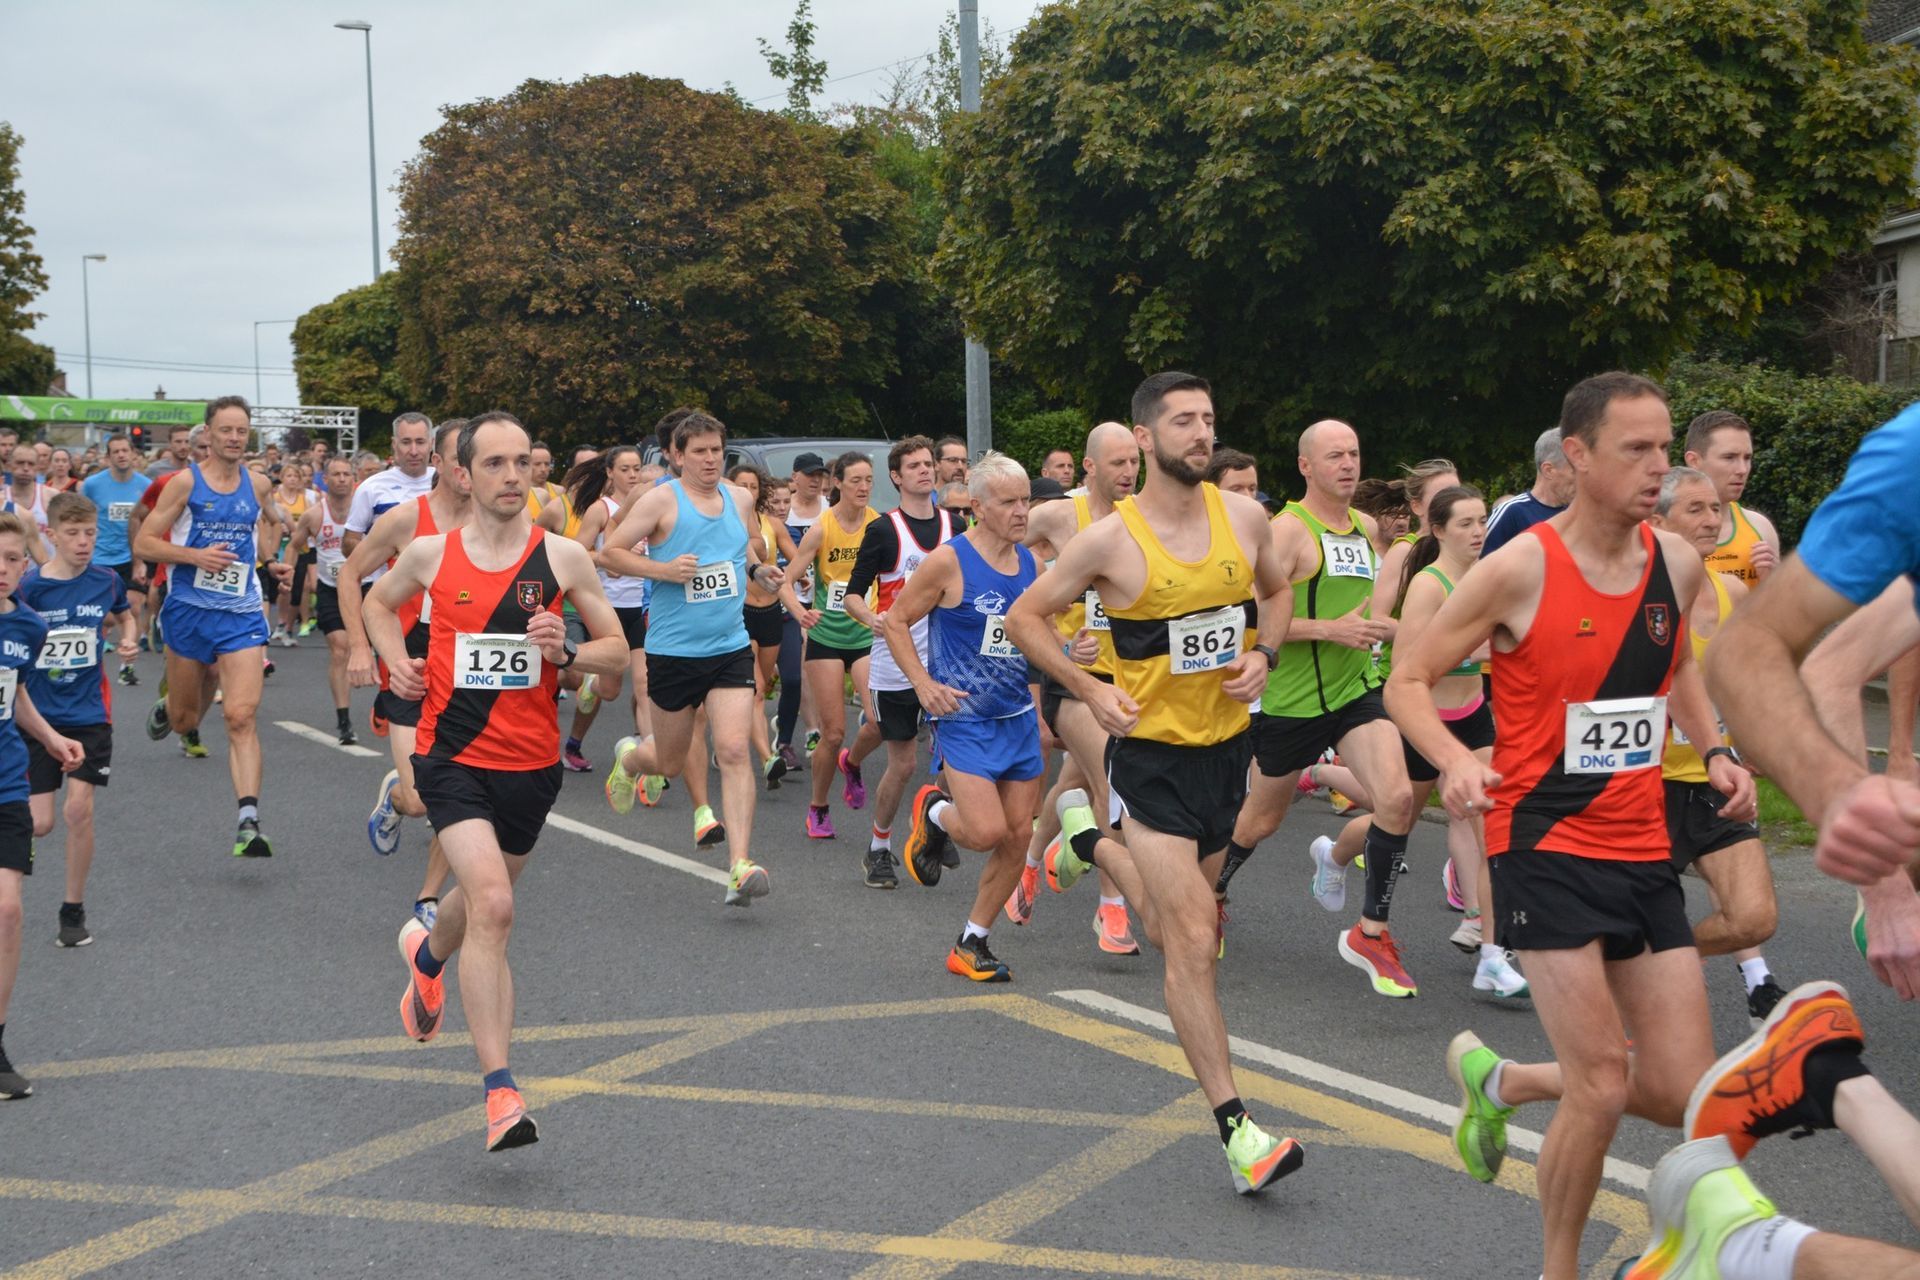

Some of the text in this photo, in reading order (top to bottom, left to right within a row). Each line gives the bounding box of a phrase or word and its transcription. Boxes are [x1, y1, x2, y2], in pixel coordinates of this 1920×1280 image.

[1332, 546, 1366, 565] 191
[1334, 564, 1353, 573] DNG
[201, 580, 220, 589] DNG
[691, 572, 730, 592] 803
[693, 591, 712, 600] DNG
[75, 604, 104, 618] DNG
[44, 640, 88, 657] 270
[1182, 626, 1236, 657] 862
[3, 640, 31, 661] DNG
[989, 645, 1007, 654] DNG
[44, 658, 65, 667] DNG
[468, 649, 529, 674] 126
[1182, 657, 1211, 670] DNG
[465, 674, 495, 686] DNG
[1580, 718, 1653, 751] 420
[1579, 753, 1616, 769] DNG
